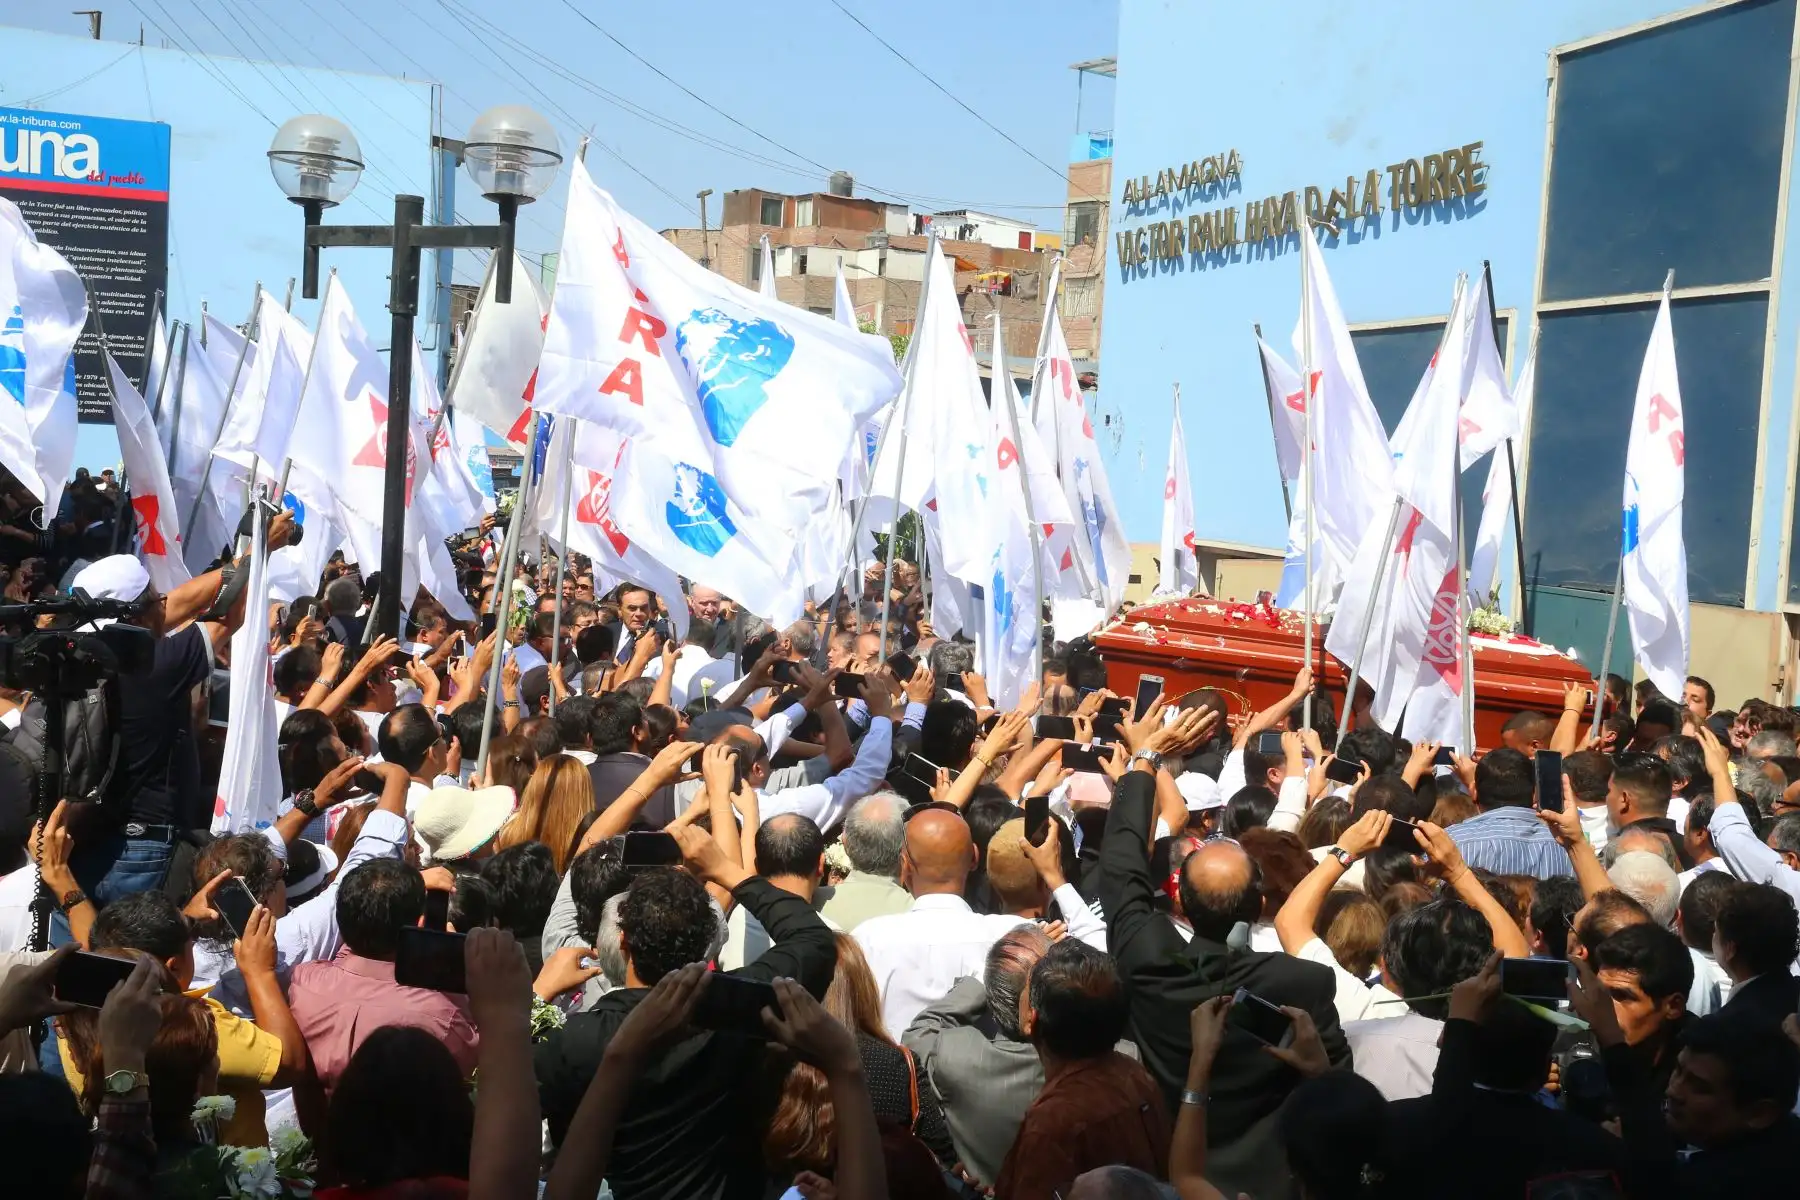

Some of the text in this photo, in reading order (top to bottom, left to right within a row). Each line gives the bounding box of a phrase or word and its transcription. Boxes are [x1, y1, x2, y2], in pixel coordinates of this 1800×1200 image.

[87, 169, 146, 188] del pueblo
[1115, 219, 1184, 268] VICTOR
[1187, 206, 1241, 254] RAUL
[1244, 190, 1299, 243] HAYA
[1345, 168, 1380, 220] LA
[1386, 140, 1488, 212] TORRE
[1122, 148, 1239, 205] AULA MAGNA
[598, 226, 667, 407] ARA
